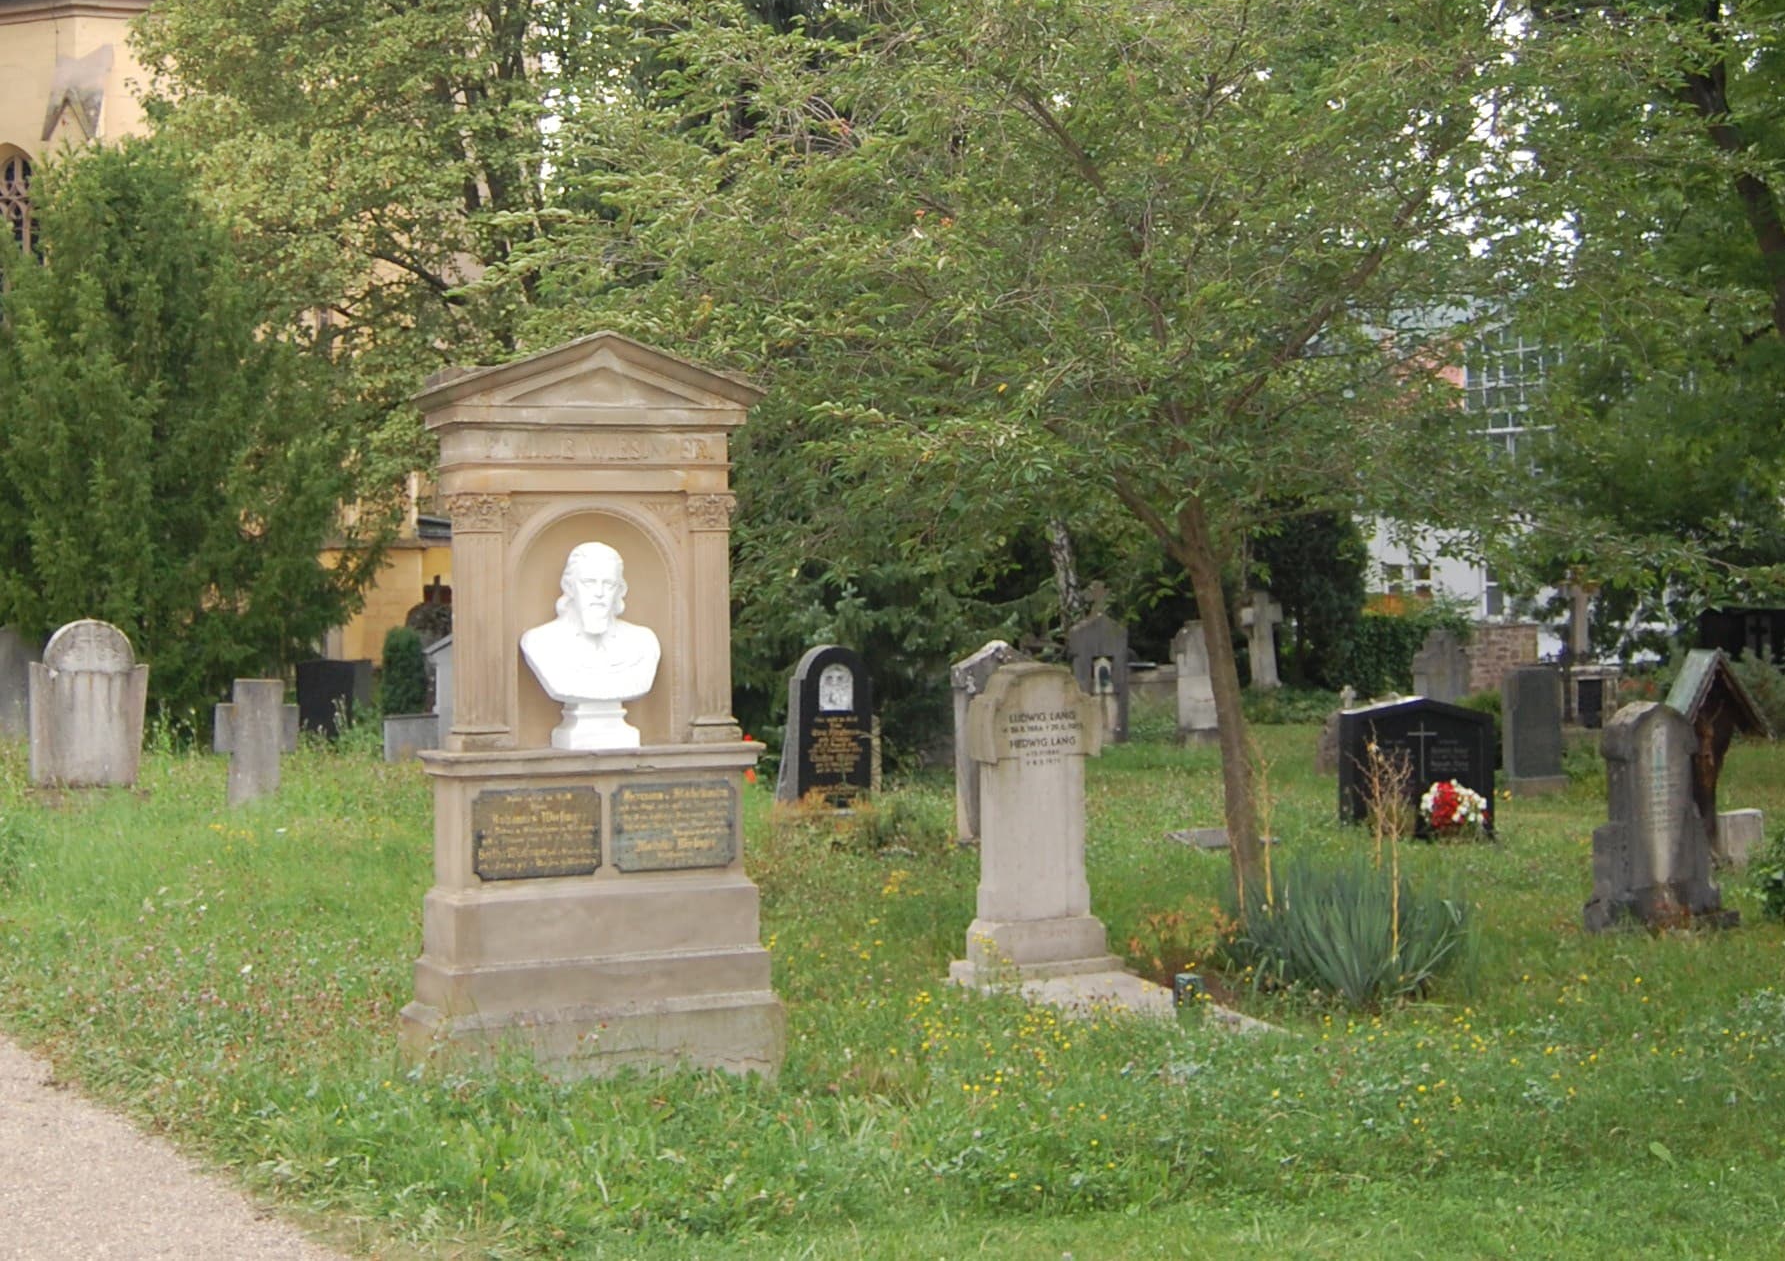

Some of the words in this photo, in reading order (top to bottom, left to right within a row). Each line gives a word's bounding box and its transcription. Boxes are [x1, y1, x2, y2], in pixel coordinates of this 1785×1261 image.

[1009, 713, 1046, 723] LUDWIG
[1050, 711, 1076, 721] LANG
[1009, 739, 1047, 749] HEDWIG
[1051, 737, 1076, 746] LANG
